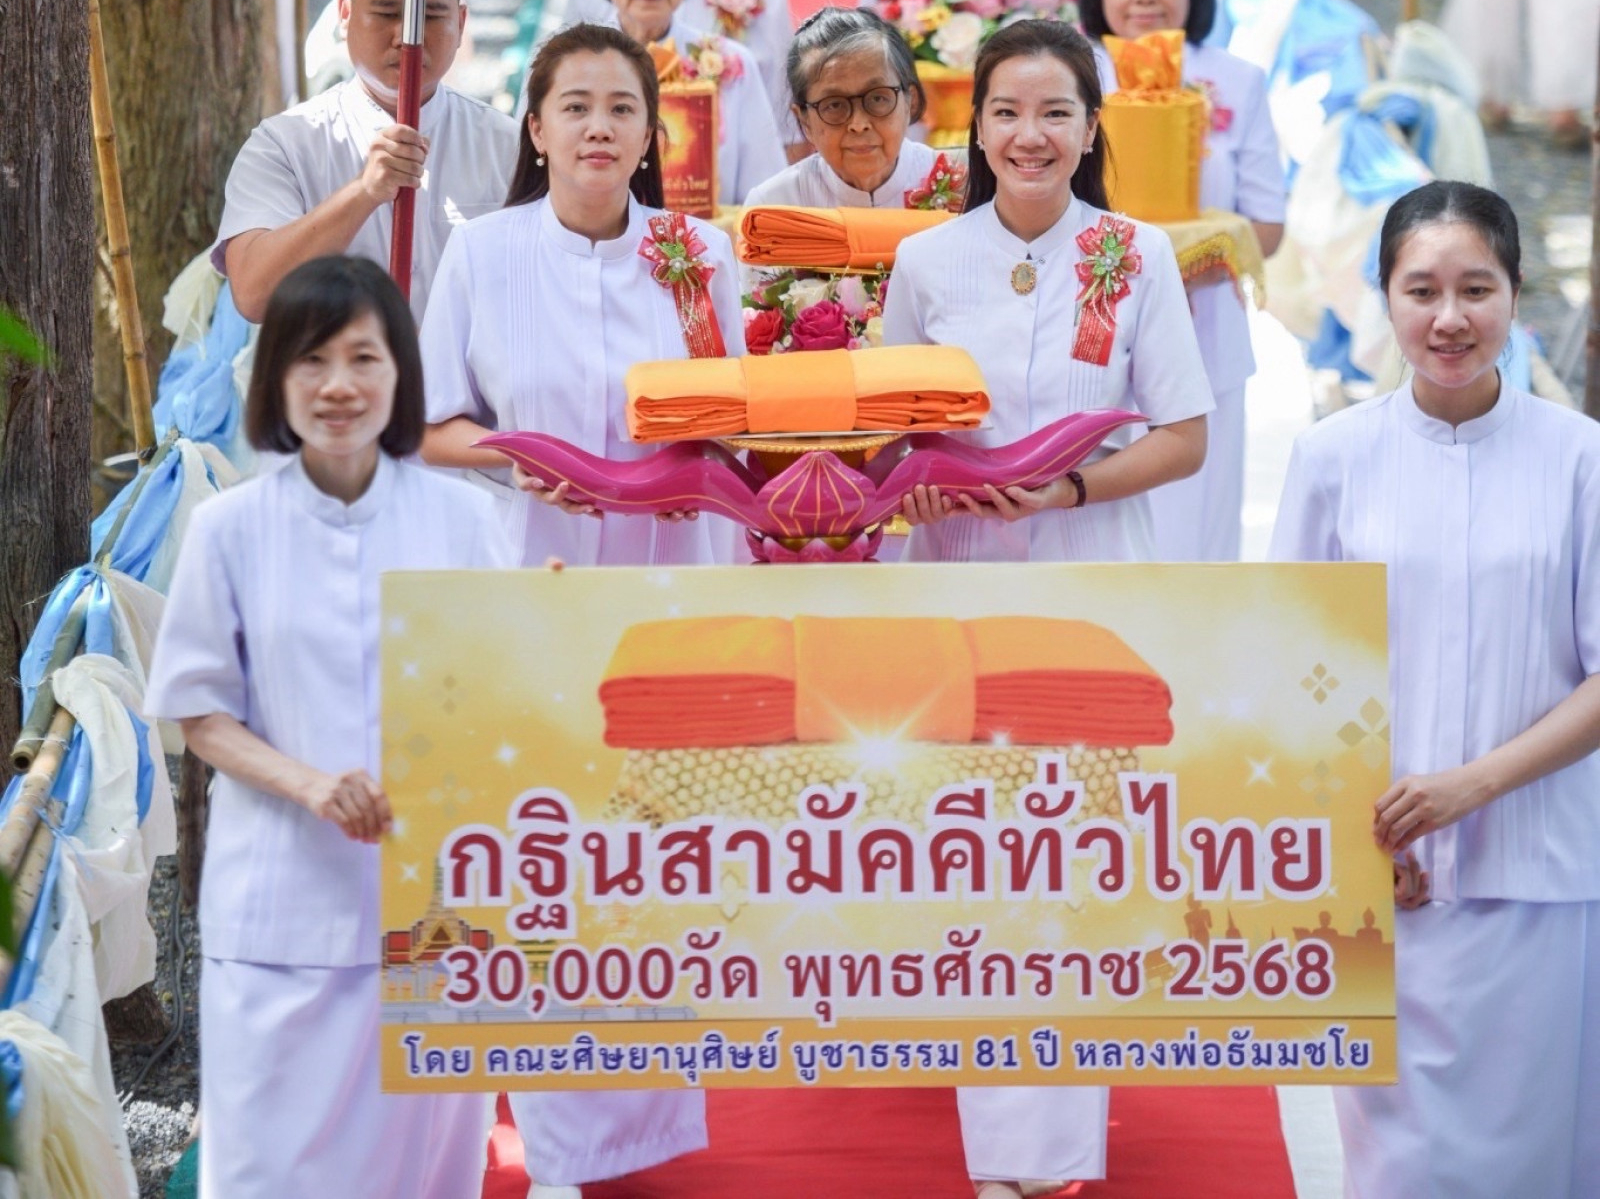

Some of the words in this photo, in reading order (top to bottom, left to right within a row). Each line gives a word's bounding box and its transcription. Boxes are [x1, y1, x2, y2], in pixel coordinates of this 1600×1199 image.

[446, 762, 1324, 930] กฐินสามัคคีทั่วไทย
[447, 933, 757, 1014] 30,000วัด
[788, 931, 1140, 1020] พุทธศักราช
[1168, 941, 1333, 998] 2568
[400, 1034, 471, 1075] โดย
[487, 1030, 781, 1083] คณะศิษยานุศิษย์
[790, 1041, 960, 1082] บูชาธรรม
[975, 1037, 1018, 1069] 81
[1033, 1029, 1058, 1069] ปี
[1074, 1028, 1370, 1069] หลวงพ่อธัมมชโย
